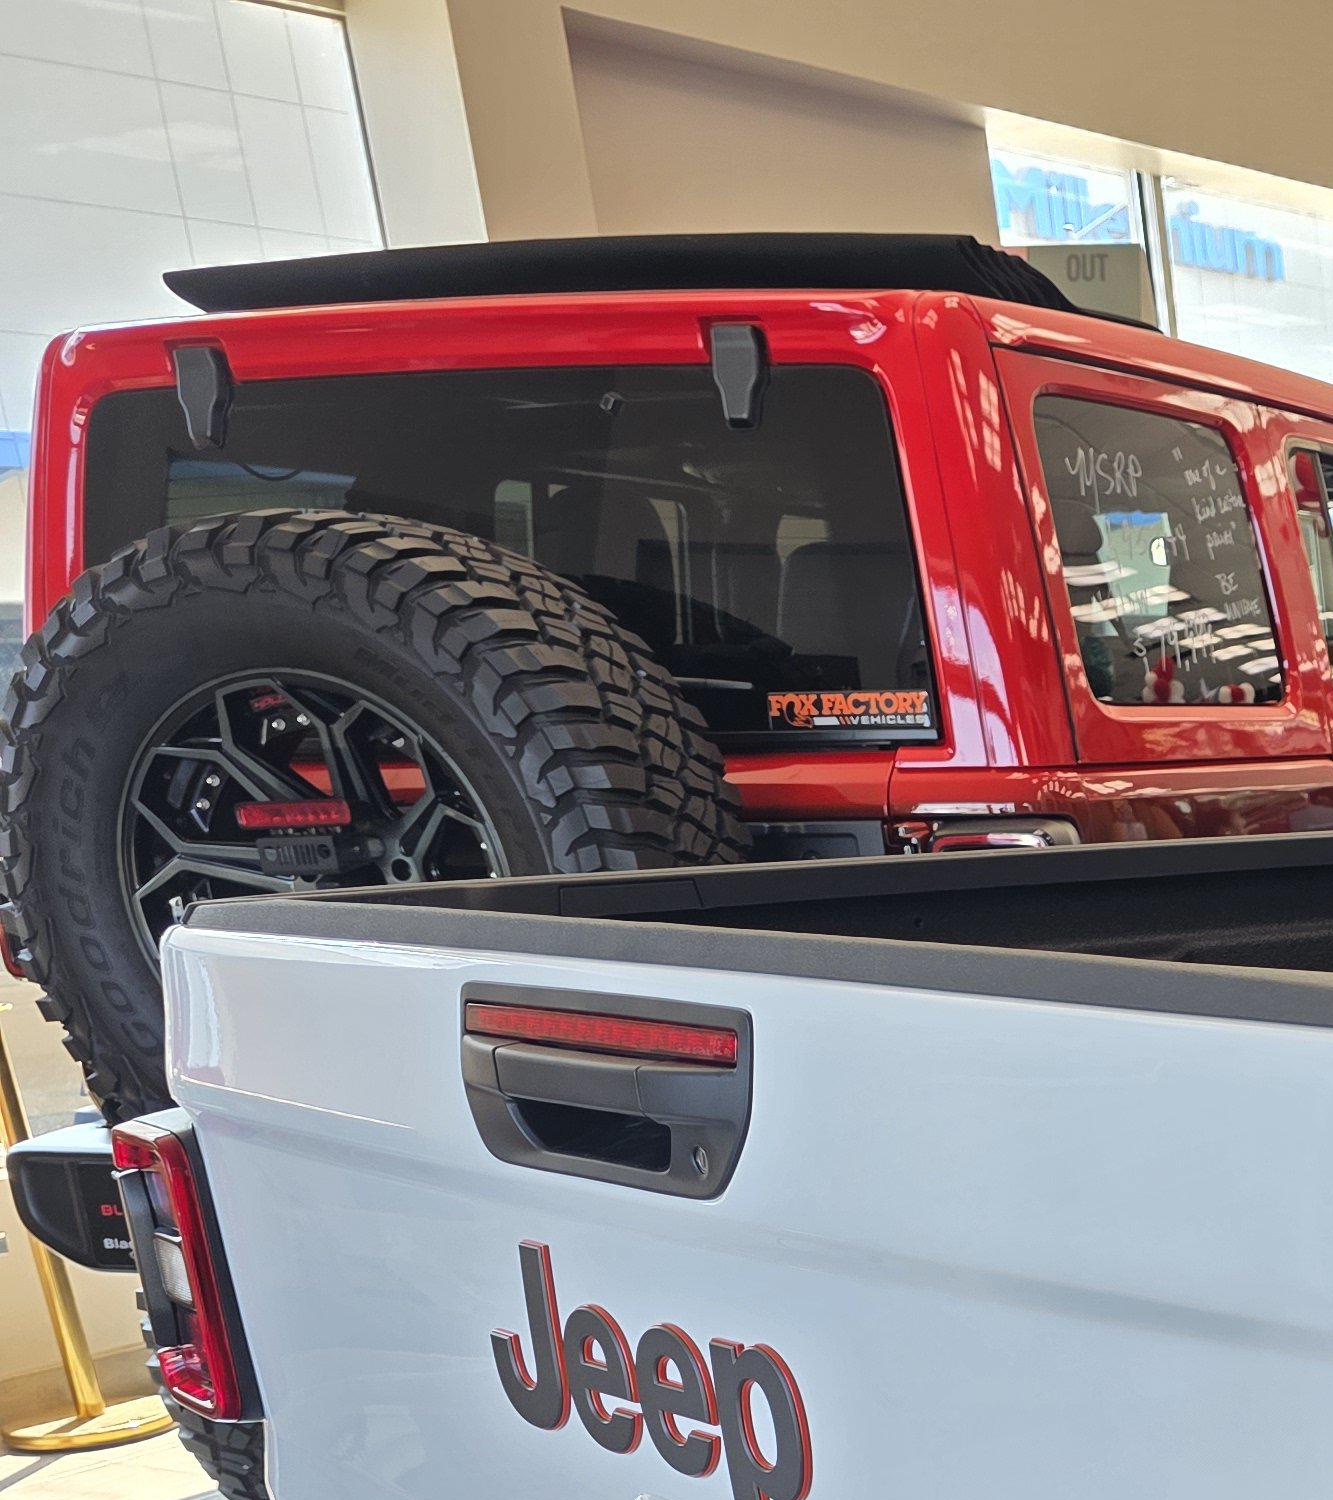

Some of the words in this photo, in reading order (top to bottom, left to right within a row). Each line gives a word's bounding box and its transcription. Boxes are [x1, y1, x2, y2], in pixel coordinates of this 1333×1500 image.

[1066, 253, 1109, 282] OUT
[1065, 447, 1143, 501] MSRP
[768, 693, 819, 724] FOX
[820, 692, 929, 715] FACTORY
[851, 713, 928, 727] VEHICLES
[100, 1204, 125, 1216] BL
